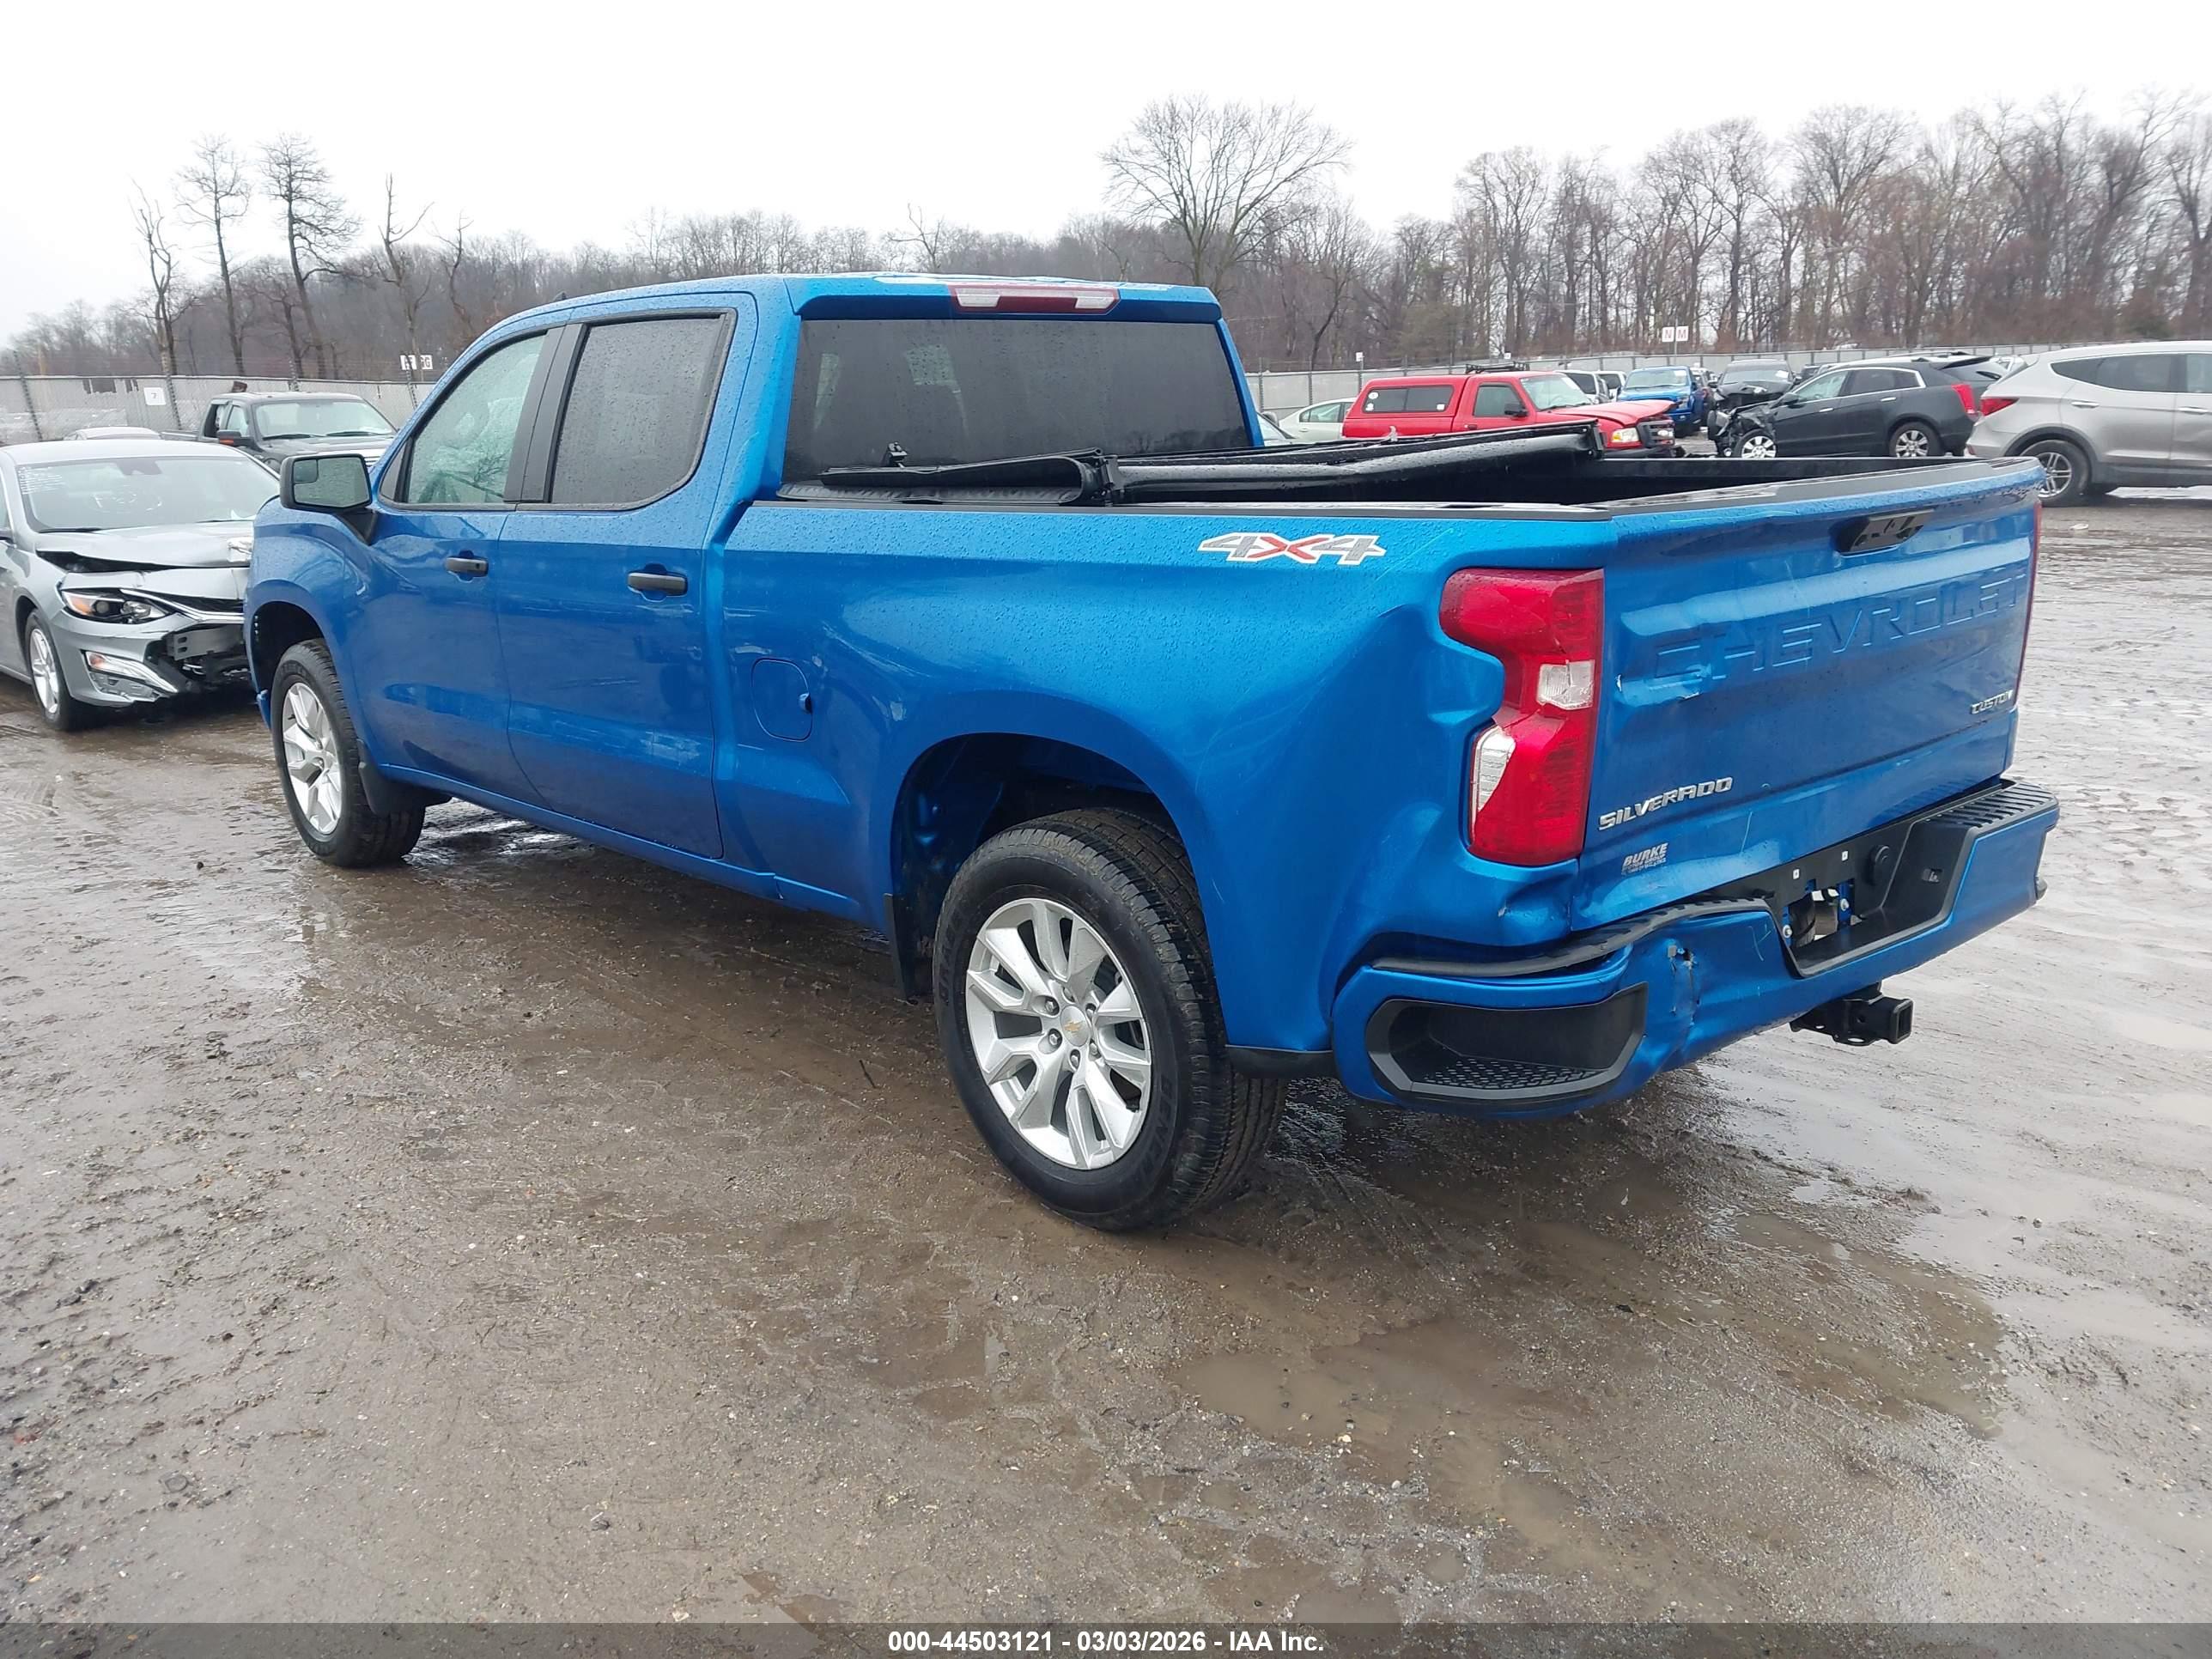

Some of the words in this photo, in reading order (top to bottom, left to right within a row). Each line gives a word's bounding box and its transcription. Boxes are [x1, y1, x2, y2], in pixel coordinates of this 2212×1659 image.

[1654, 568, 2027, 684] CHEVROLET
[1971, 690, 2014, 714] CUSTOM
[1598, 776, 1733, 831] SILVERADO
[1622, 842, 1668, 866] BURKE
